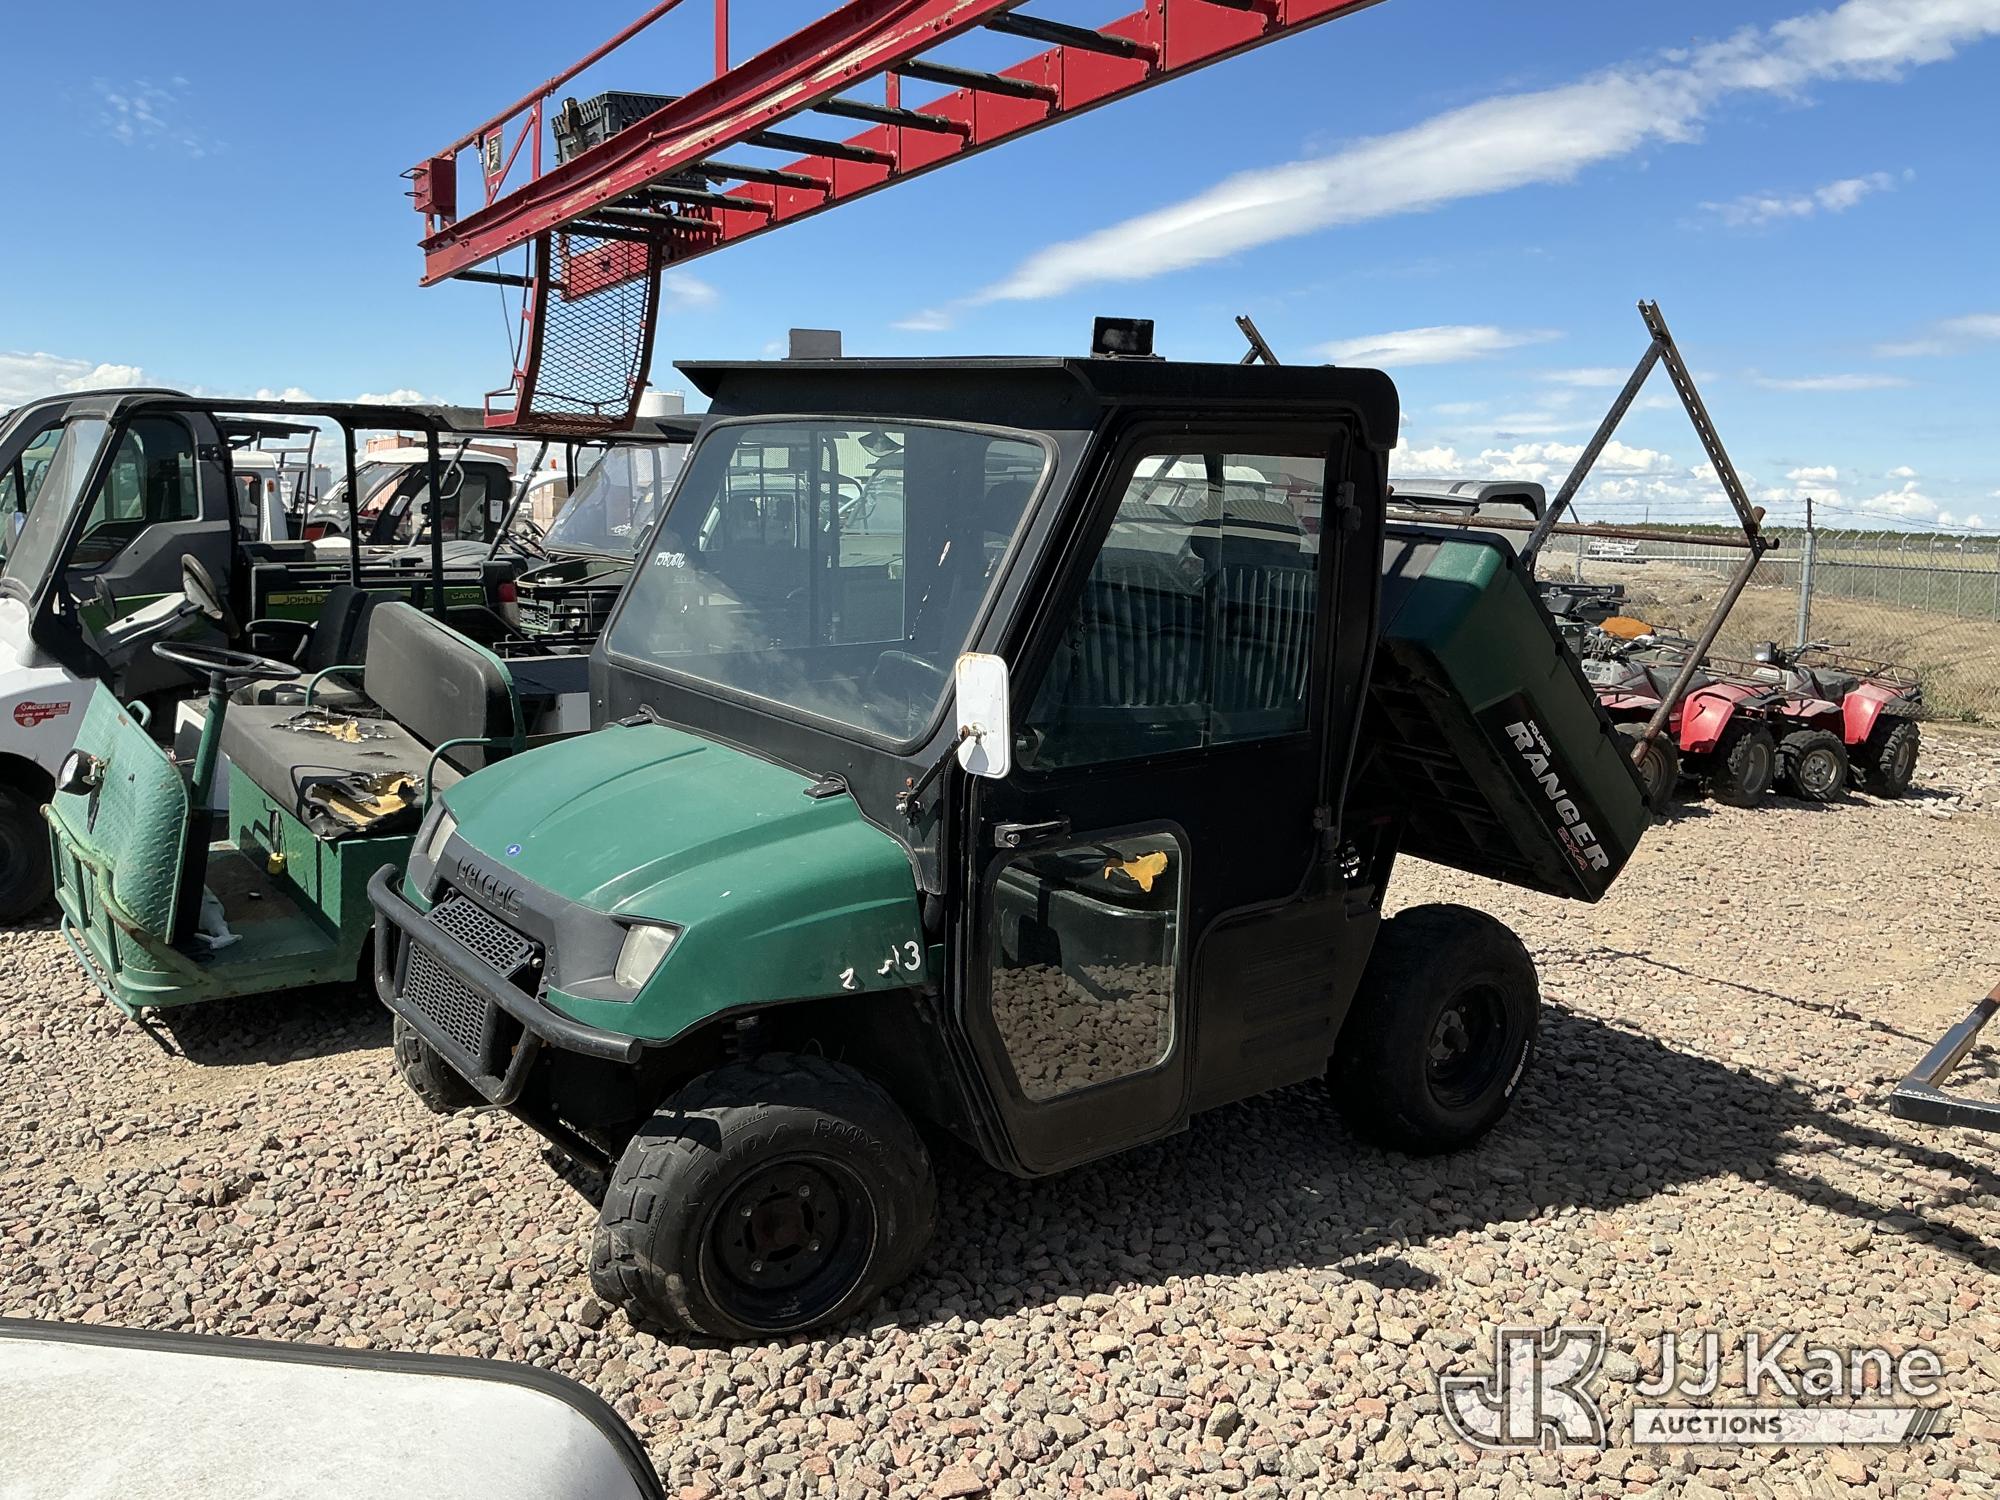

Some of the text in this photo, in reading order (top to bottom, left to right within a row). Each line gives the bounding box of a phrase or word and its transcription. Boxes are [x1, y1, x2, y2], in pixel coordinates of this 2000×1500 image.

[451, 592, 480, 600] GATOR
[1527, 720, 1552, 757] POLARIS
[1504, 721, 1609, 872] RANGER
[456, 856, 525, 917] POLARIS
